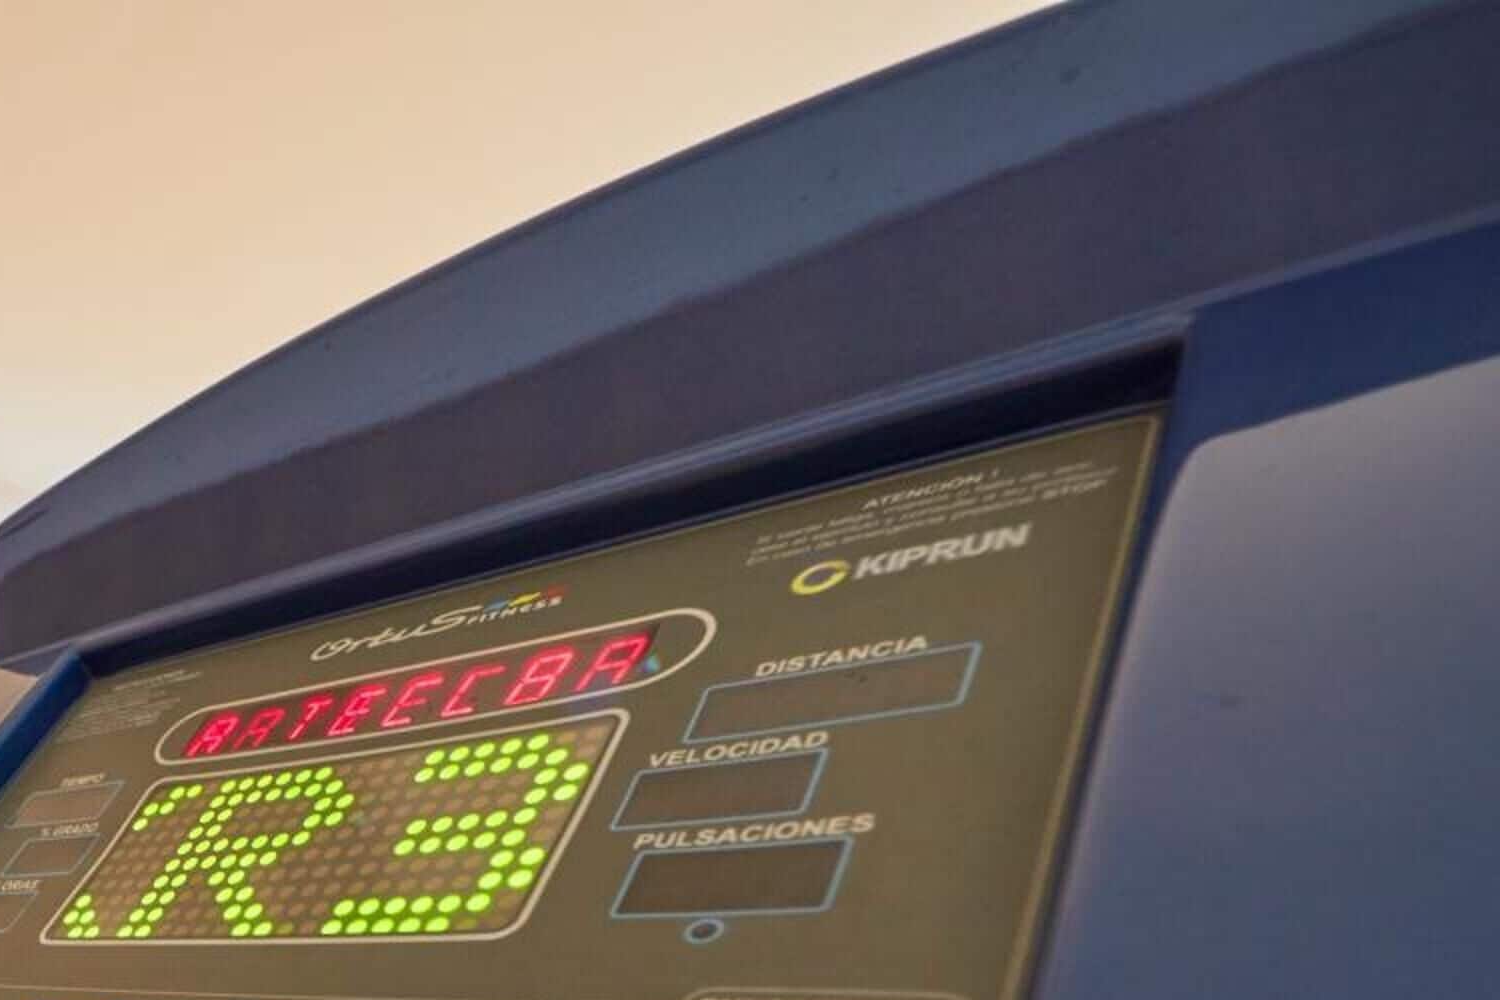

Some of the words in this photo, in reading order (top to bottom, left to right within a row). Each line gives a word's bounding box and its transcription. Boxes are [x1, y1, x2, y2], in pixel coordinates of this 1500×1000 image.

[853, 523, 1034, 580] KIPRUN
[754, 635, 930, 678] DISTANCIA
[648, 731, 829, 769] VELOCIDAD
[632, 813, 876, 850] PULSACIONES
